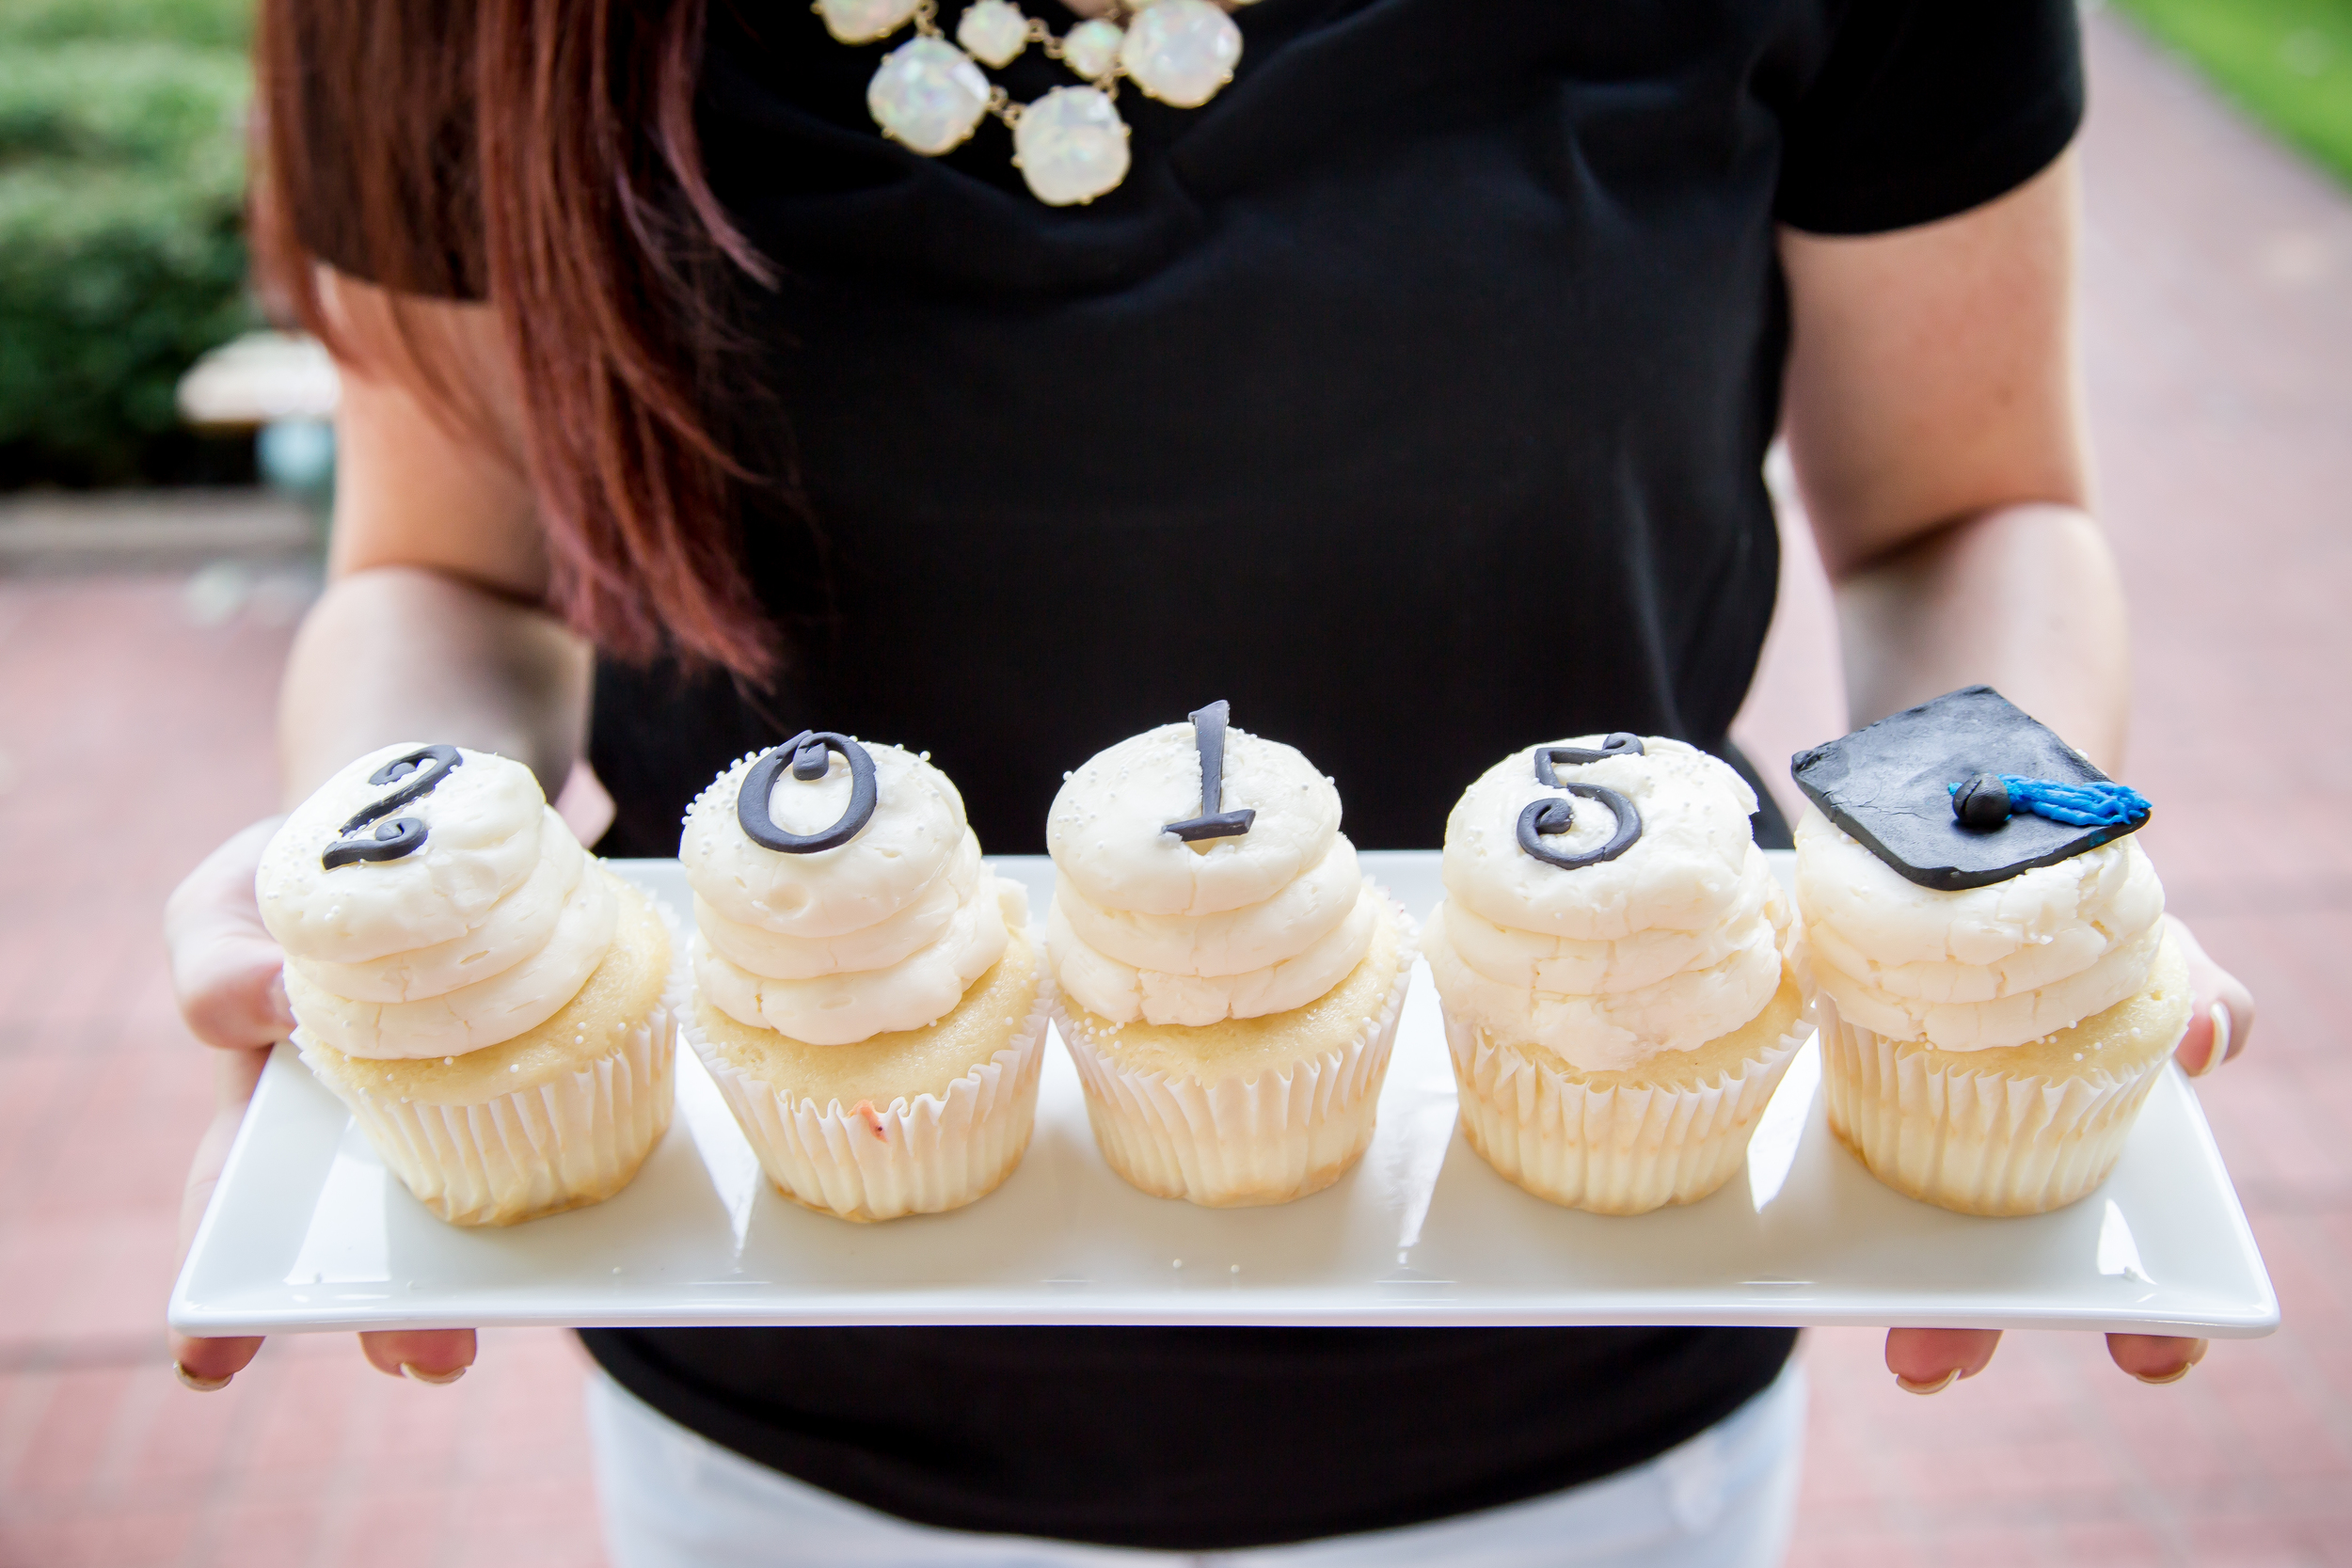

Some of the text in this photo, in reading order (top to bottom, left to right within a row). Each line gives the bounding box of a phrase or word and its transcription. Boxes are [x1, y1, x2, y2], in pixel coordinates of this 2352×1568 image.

[322, 744, 463, 871] 2
[1161, 699, 1256, 843] 1
[1516, 732, 1645, 870] 5
